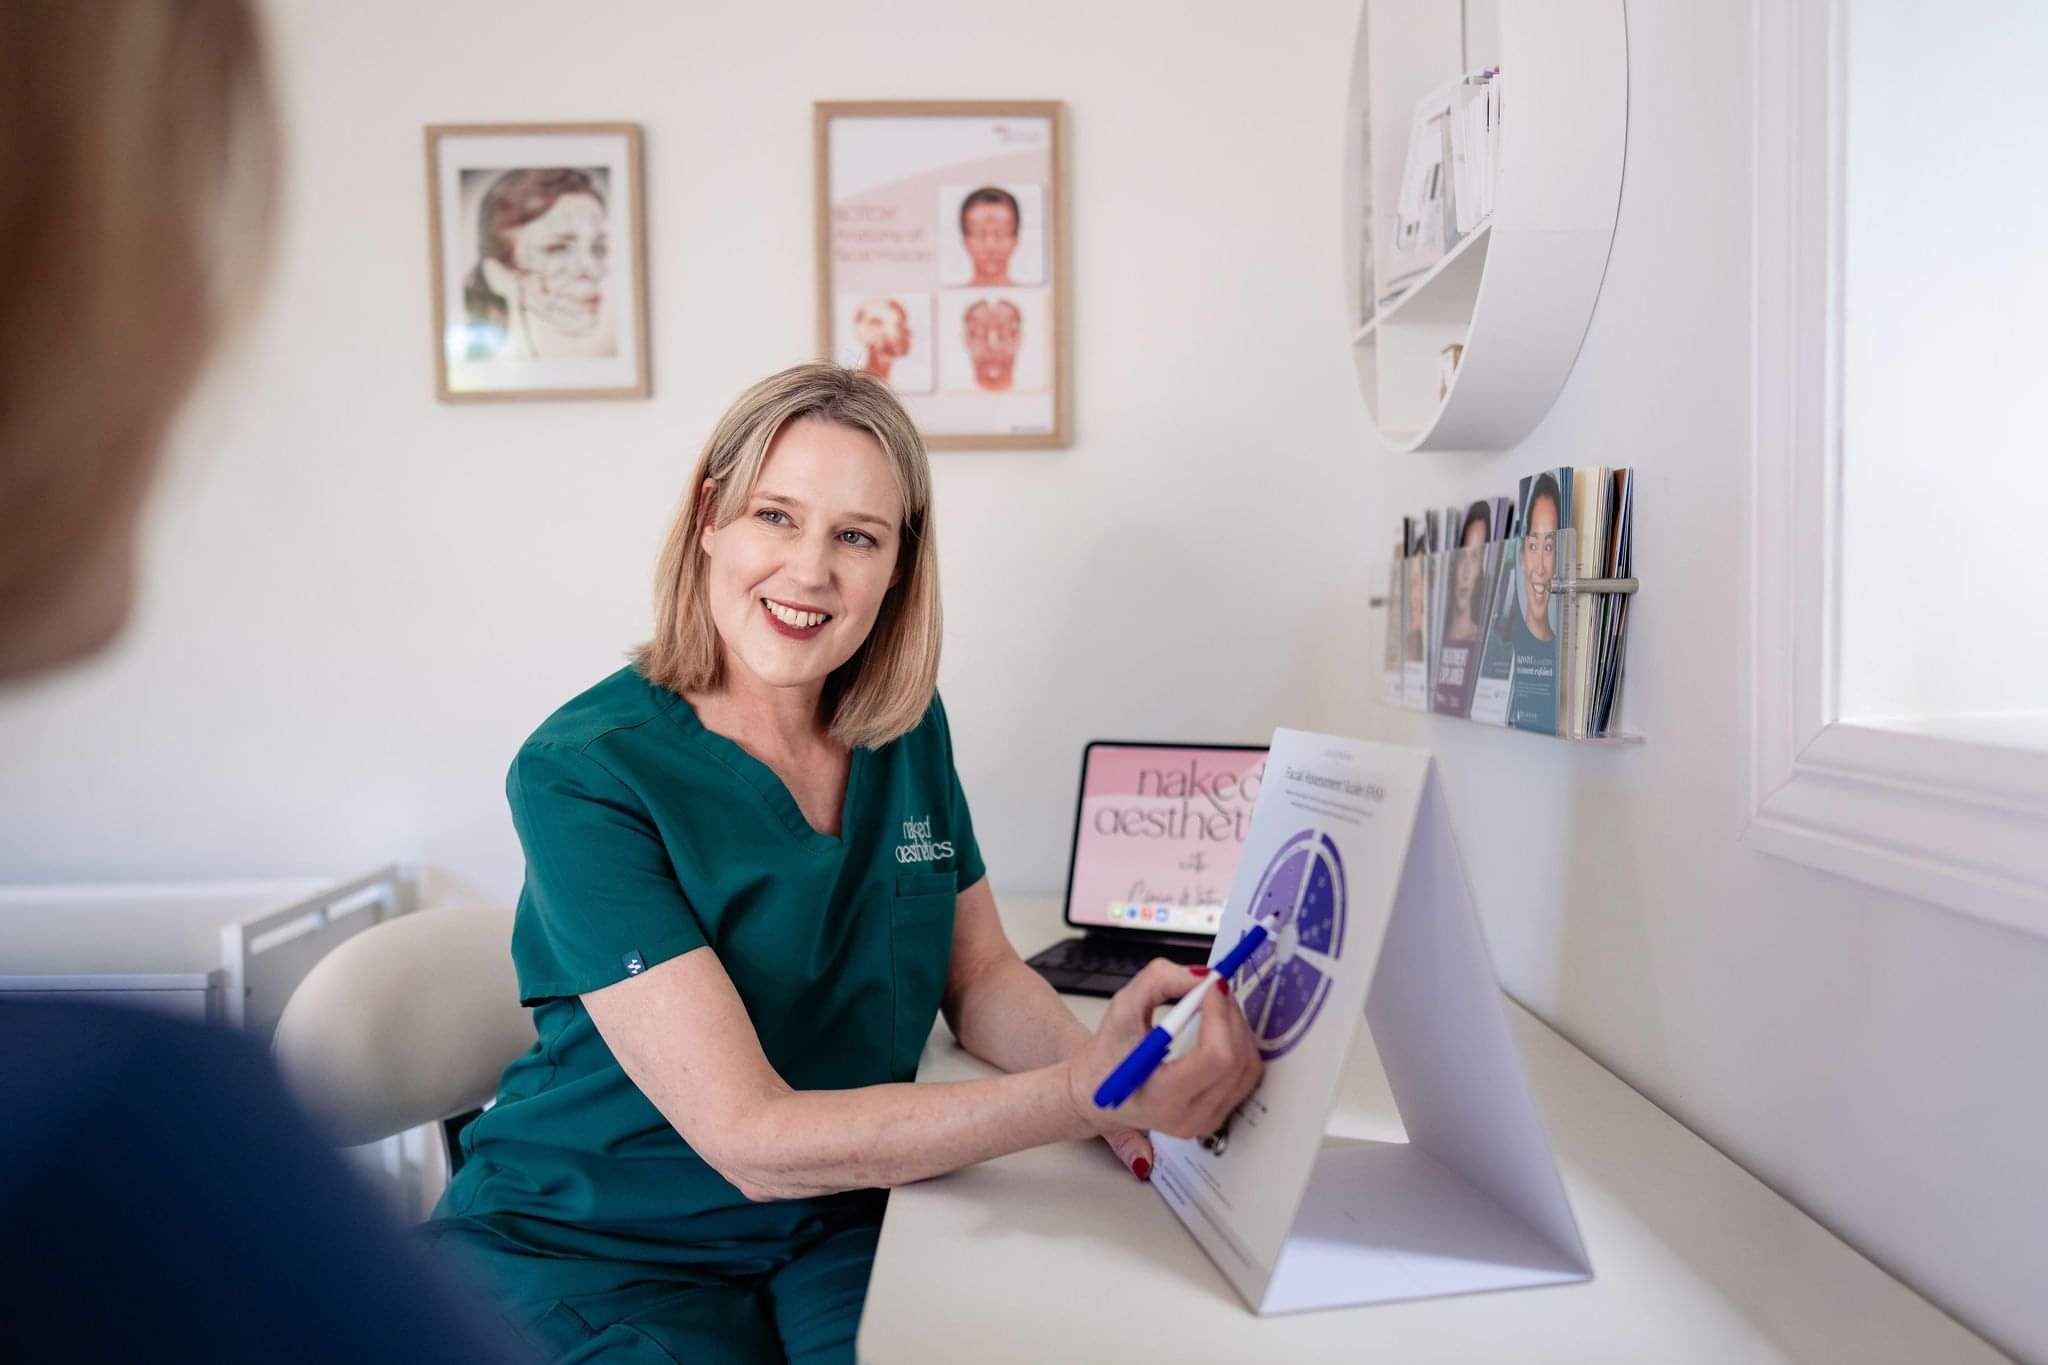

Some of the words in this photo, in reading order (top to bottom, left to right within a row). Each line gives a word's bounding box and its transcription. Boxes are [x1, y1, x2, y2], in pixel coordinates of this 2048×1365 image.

[1137, 759, 1266, 814] naked
[903, 815, 931, 842] naked
[1094, 800, 1253, 842] aesthet
[895, 838, 955, 863] aesthetics
